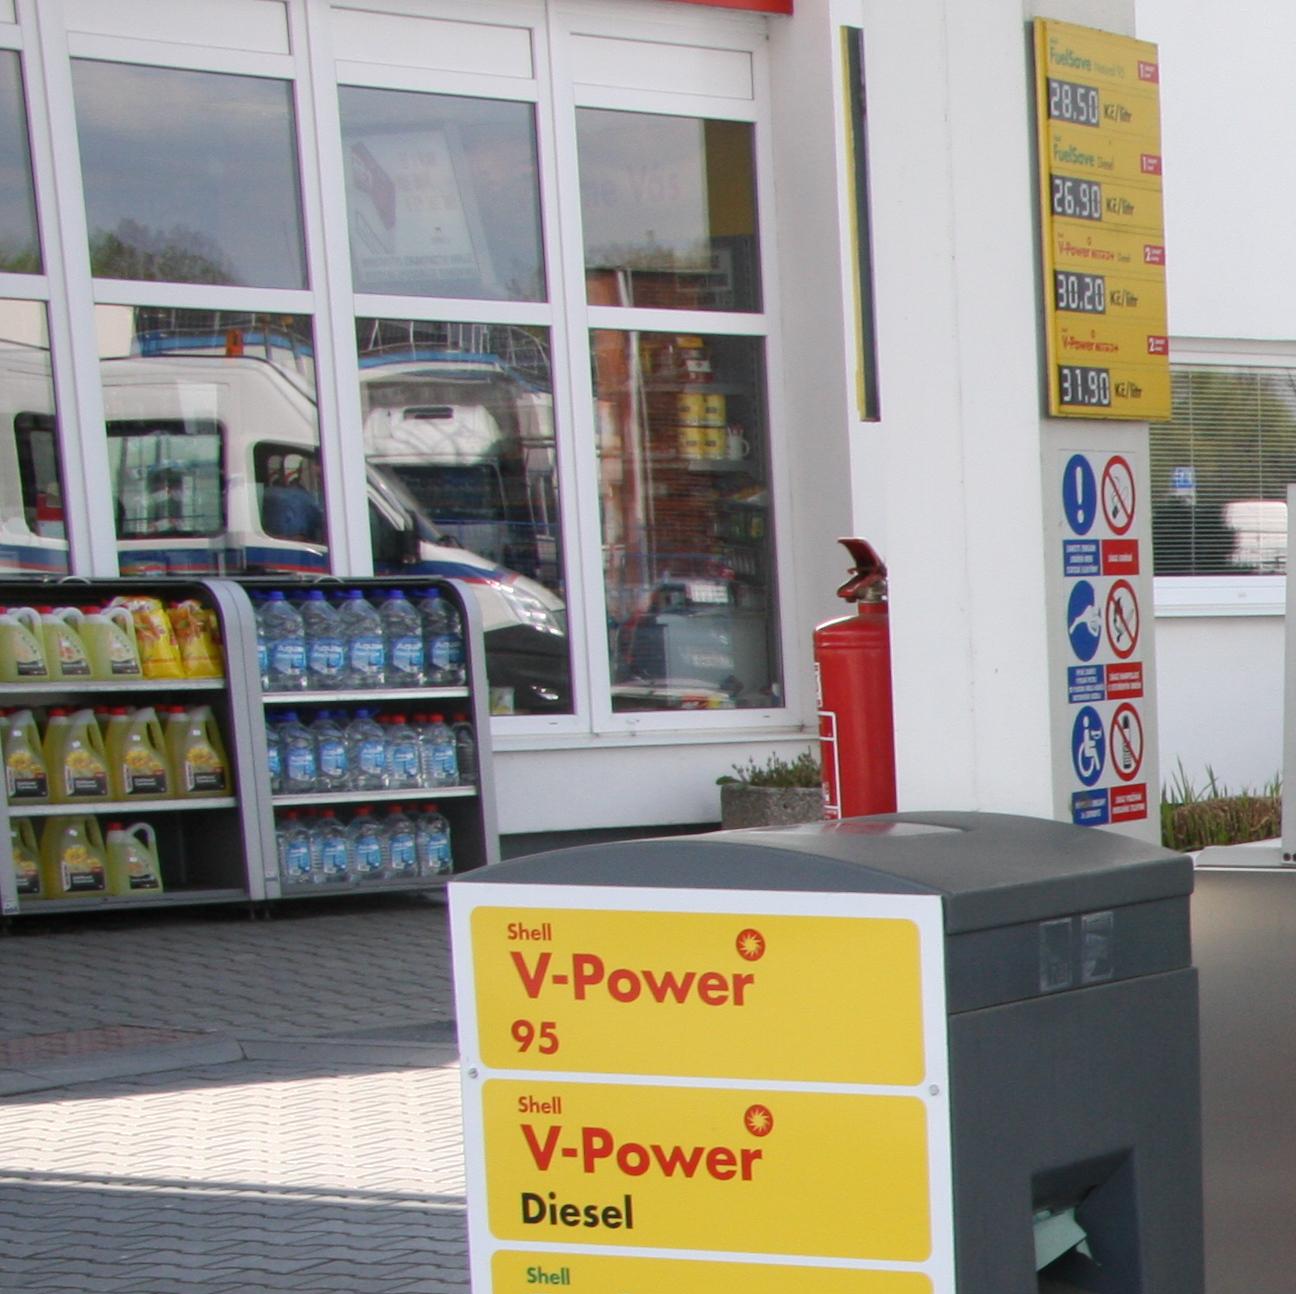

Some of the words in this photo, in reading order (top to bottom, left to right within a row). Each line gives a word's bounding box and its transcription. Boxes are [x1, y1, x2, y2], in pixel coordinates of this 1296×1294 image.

[1050, 82, 1099, 124] 28.50
[1054, 178, 1101, 218] 26.90
[1057, 274, 1106, 312] 30.20
[1061, 368, 1110, 405] 31.90
[508, 922, 552, 942] Shell
[510, 951, 755, 1007] V-Power
[511, 1019, 560, 1056] 95
[518, 1095, 562, 1115] Shell
[520, 1124, 763, 1182] V-Power
[521, 1192, 634, 1230] Diesel
[526, 1267, 571, 1286] Shell
